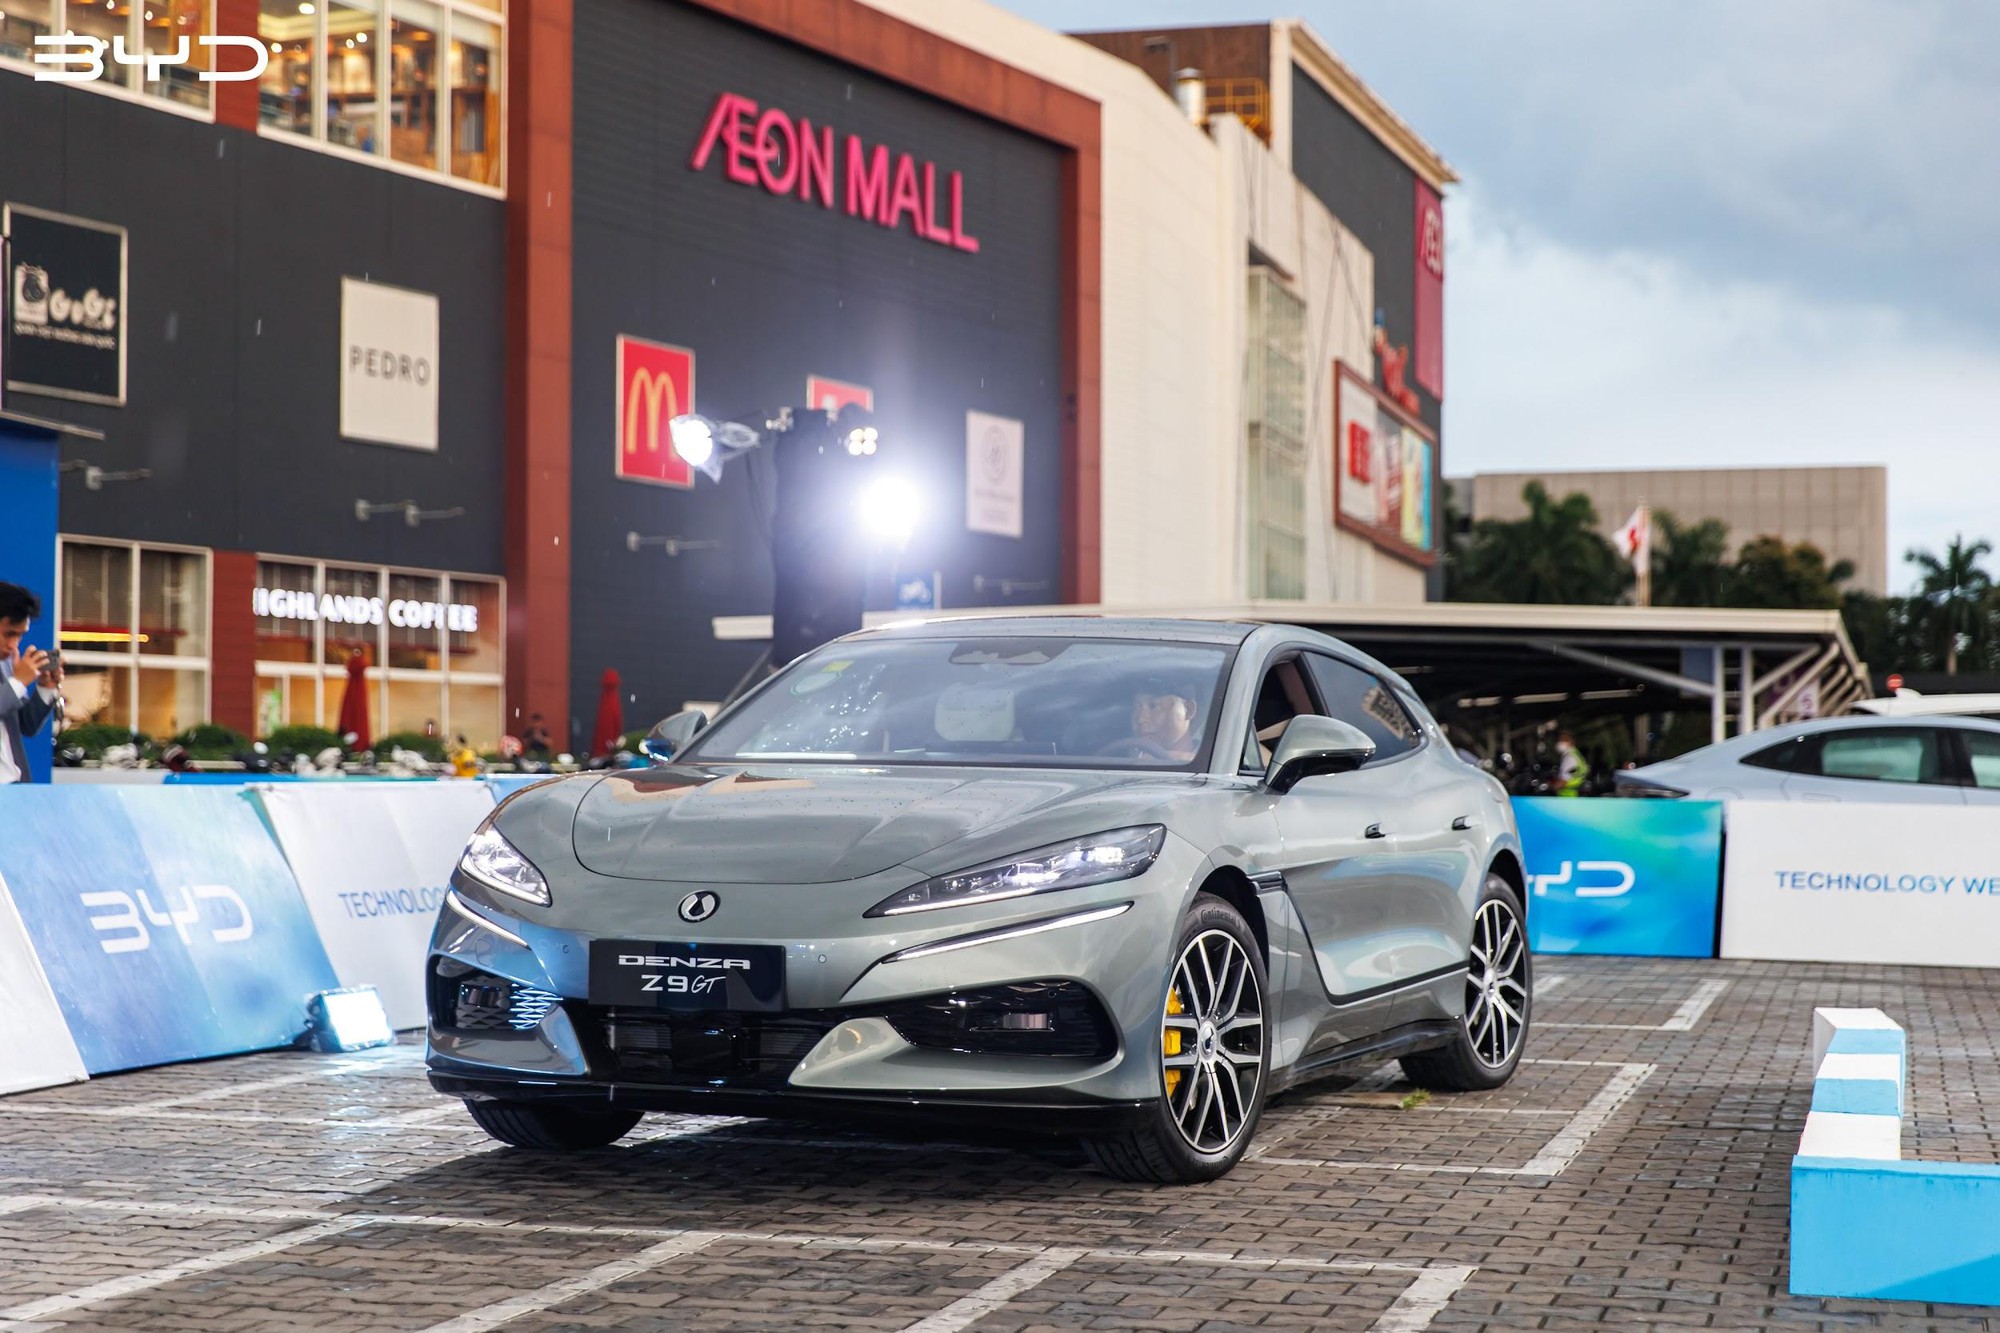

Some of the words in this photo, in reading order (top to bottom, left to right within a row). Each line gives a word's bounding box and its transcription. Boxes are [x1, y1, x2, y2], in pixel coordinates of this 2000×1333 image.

[846, 134, 980, 253] MALL
[349, 344, 431, 387] PEDRO
[1526, 860, 1636, 898] YD
[1774, 870, 1957, 894] TECHNOLOGY
[79, 884, 254, 954] BYD
[618, 954, 751, 970] DENZA
